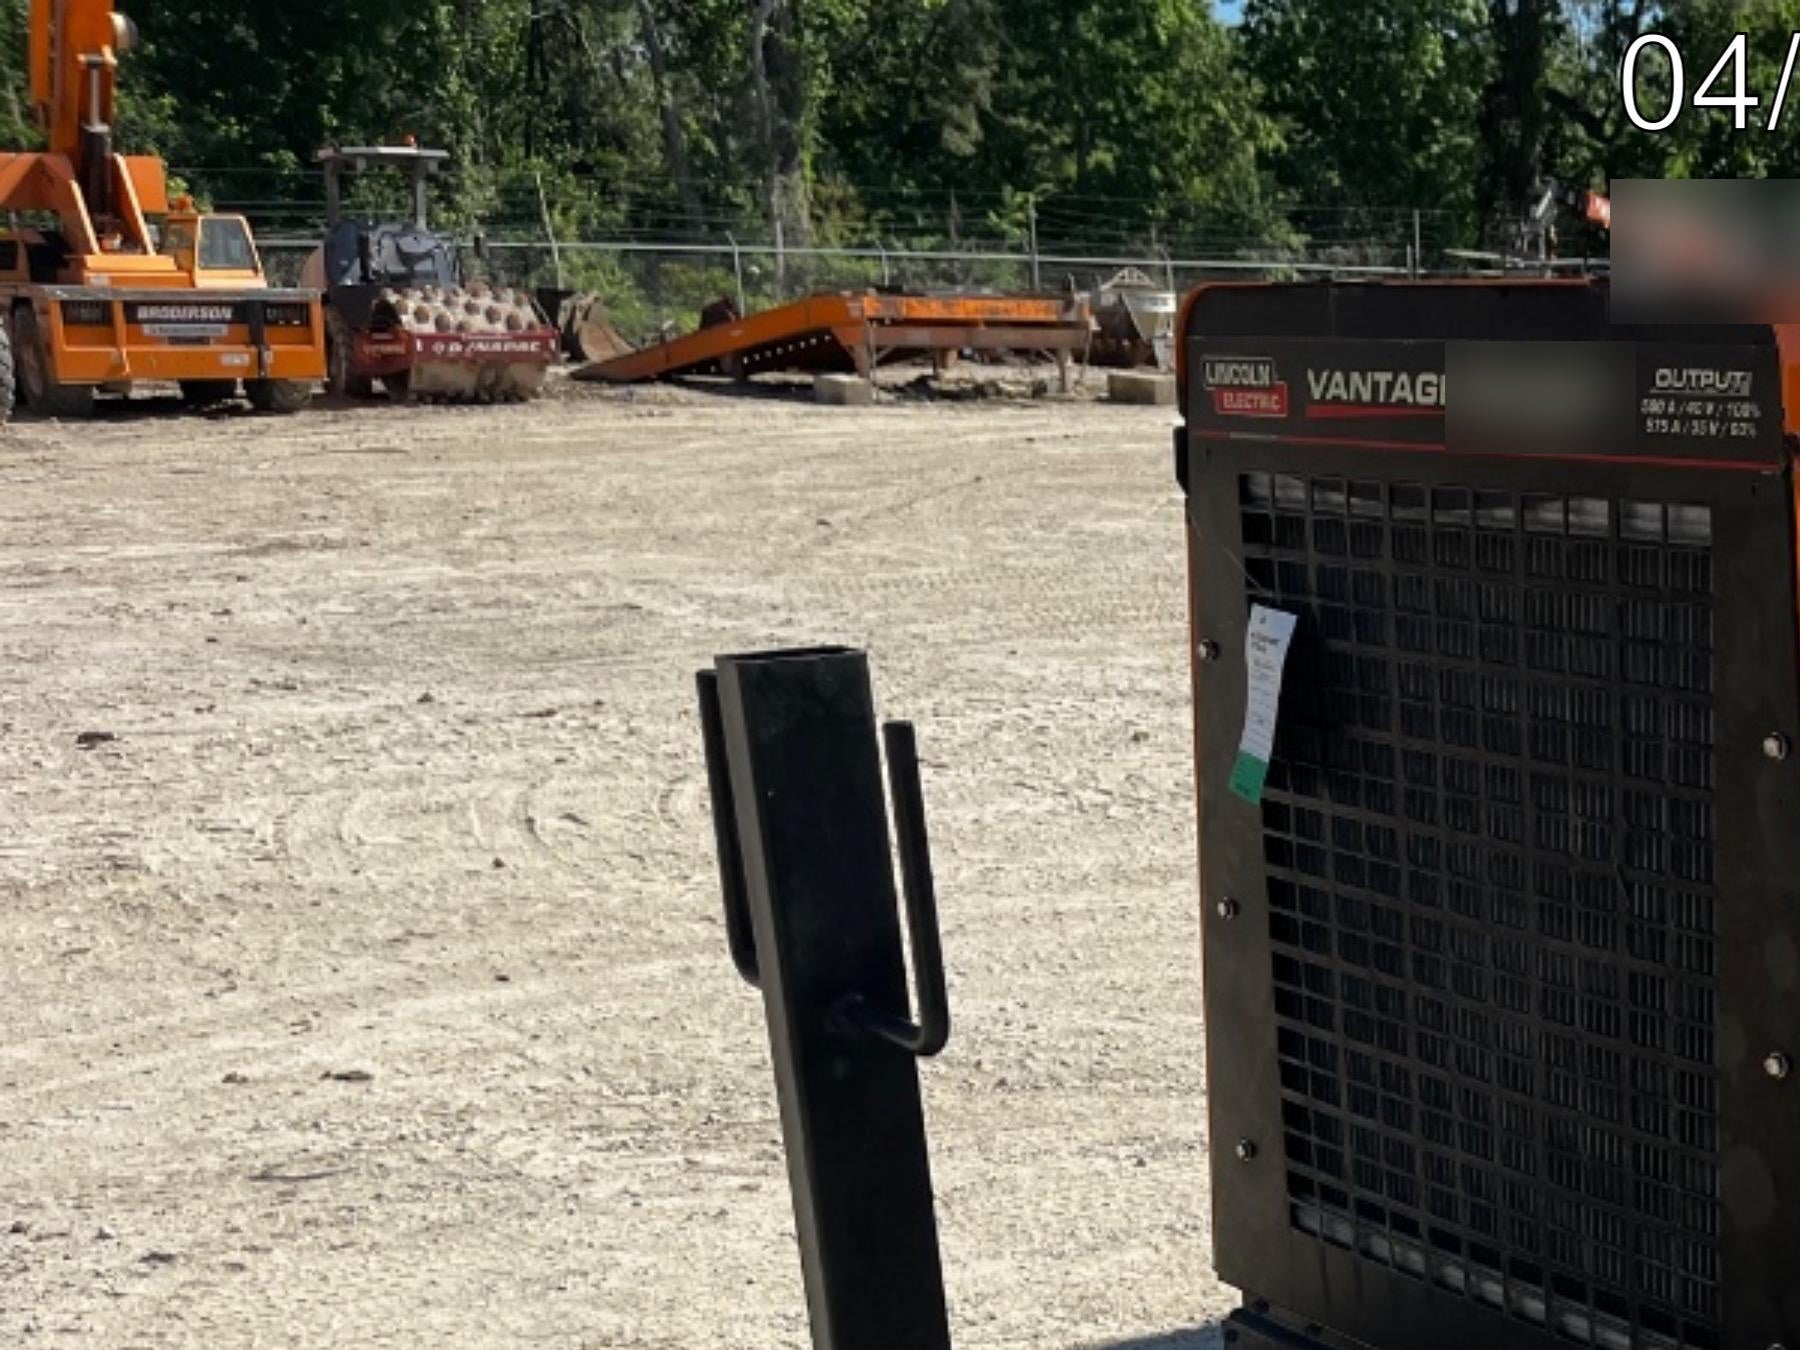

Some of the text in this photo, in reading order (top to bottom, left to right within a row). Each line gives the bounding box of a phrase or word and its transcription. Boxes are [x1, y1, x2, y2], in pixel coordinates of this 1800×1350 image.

[1205, 361, 1271, 386] LINCOLN
[1655, 367, 1745, 391] OUTPUT
[1307, 367, 1446, 407] VANTAG
[1223, 391, 1281, 410] ELECTRIC
